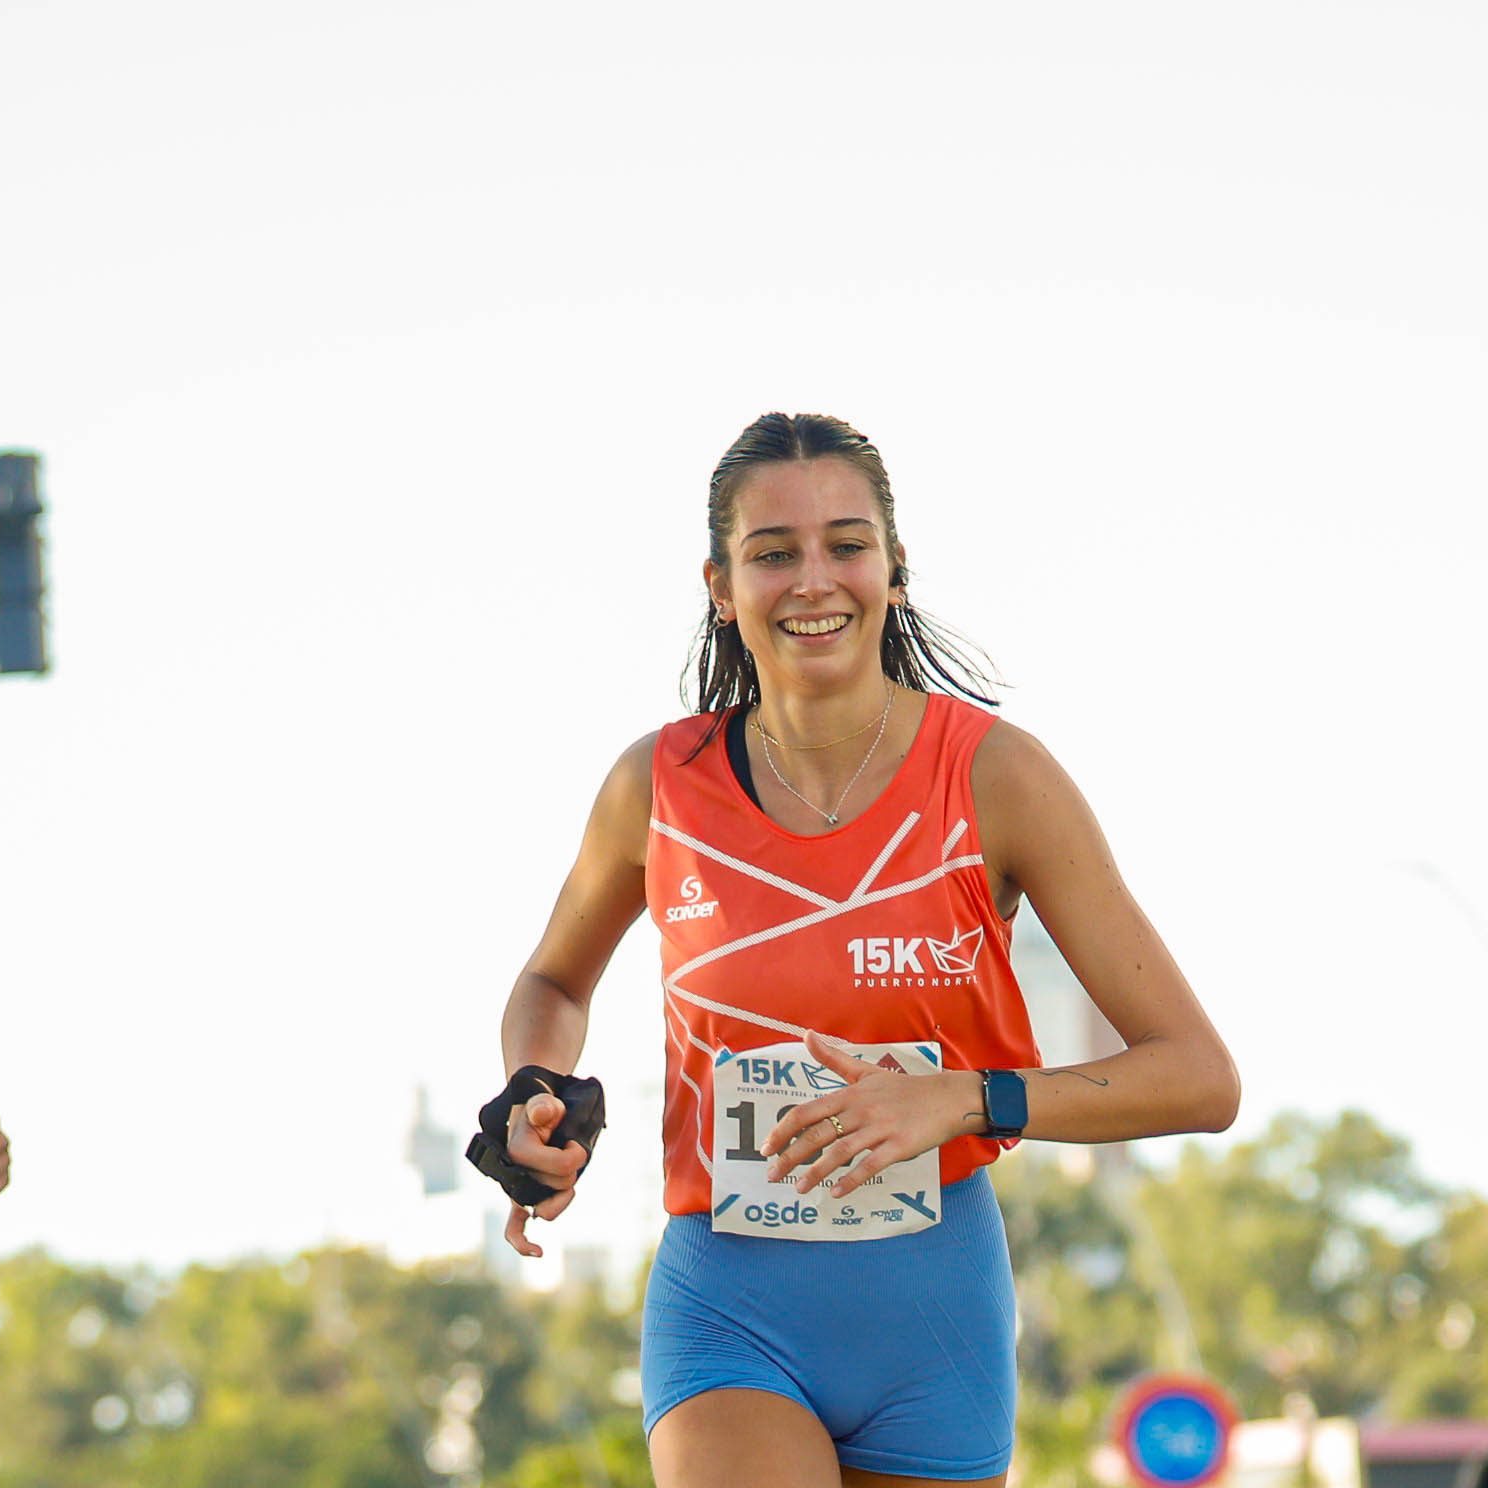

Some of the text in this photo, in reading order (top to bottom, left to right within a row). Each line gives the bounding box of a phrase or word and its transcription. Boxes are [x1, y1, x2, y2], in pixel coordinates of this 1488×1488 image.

[847, 937, 925, 975] 15K
[854, 977, 925, 988] PUERTO
[736, 1058, 797, 1088] 15K
[744, 1200, 818, 1226] osde
